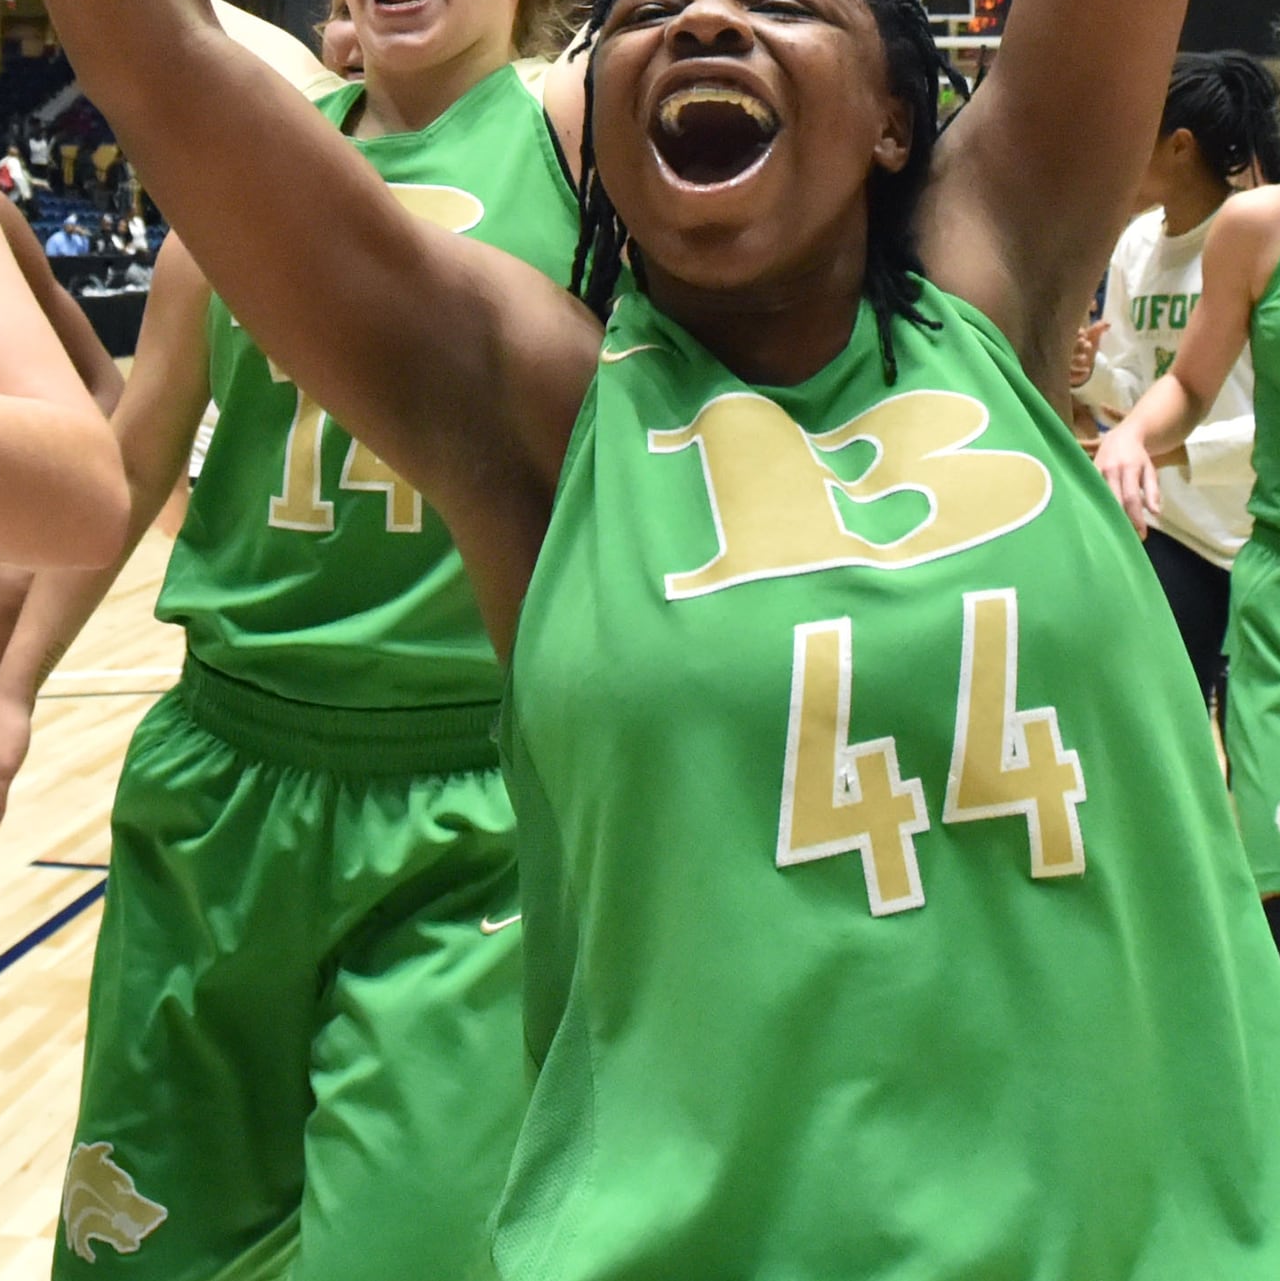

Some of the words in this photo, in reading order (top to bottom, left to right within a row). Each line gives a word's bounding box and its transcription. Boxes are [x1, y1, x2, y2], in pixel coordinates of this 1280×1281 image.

[1131, 292, 1201, 331] UFO
[647, 389, 1052, 601] B
[776, 587, 1087, 918] 44
